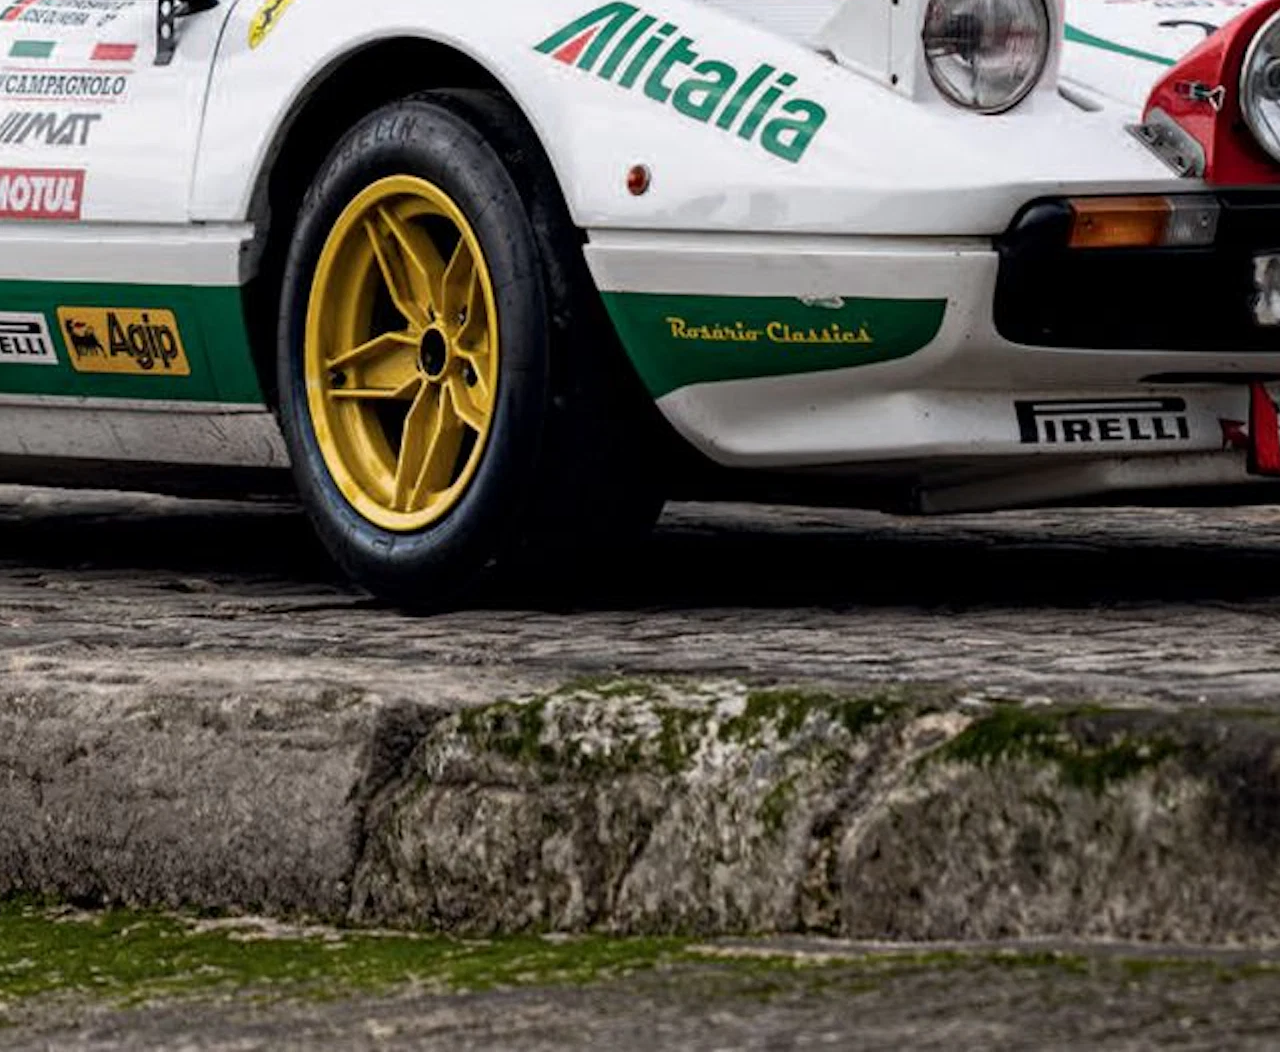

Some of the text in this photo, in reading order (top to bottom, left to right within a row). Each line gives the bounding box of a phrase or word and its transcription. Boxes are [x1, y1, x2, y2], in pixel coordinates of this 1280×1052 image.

[532, 1, 828, 163] Alitalia
[105, 311, 180, 370] Agip
[766, 322, 874, 344] Classics
[1015, 397, 1192, 444] PIRELLI
